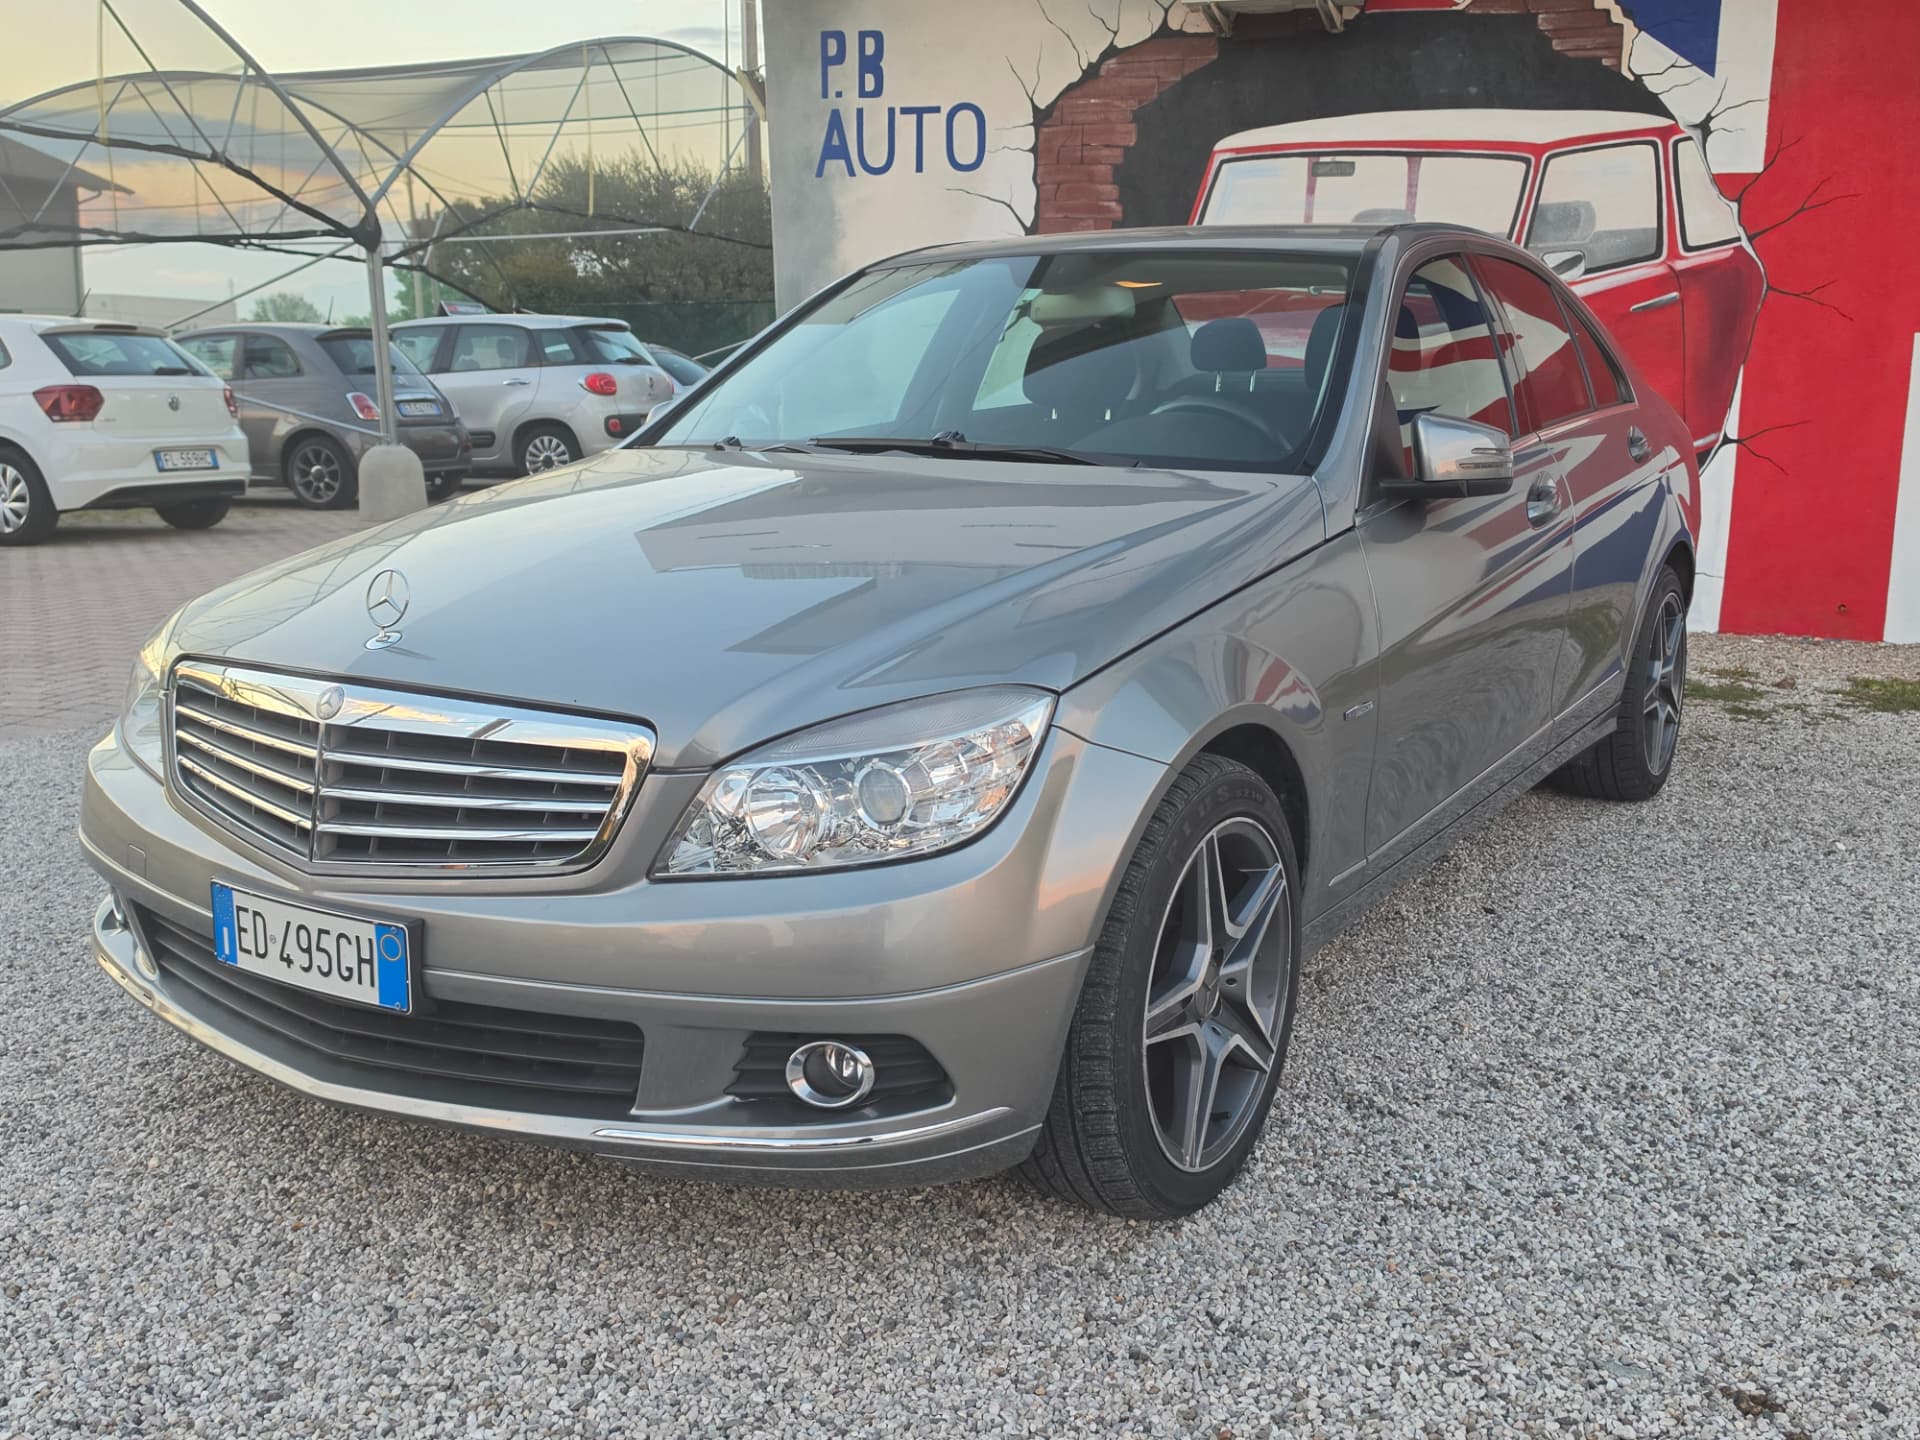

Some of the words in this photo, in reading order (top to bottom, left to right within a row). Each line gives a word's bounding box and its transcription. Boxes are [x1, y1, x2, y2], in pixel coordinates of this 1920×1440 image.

[815, 102, 987, 178] AUTO
[235, 904, 268, 959] ED
[279, 920, 376, 988] 495GH
